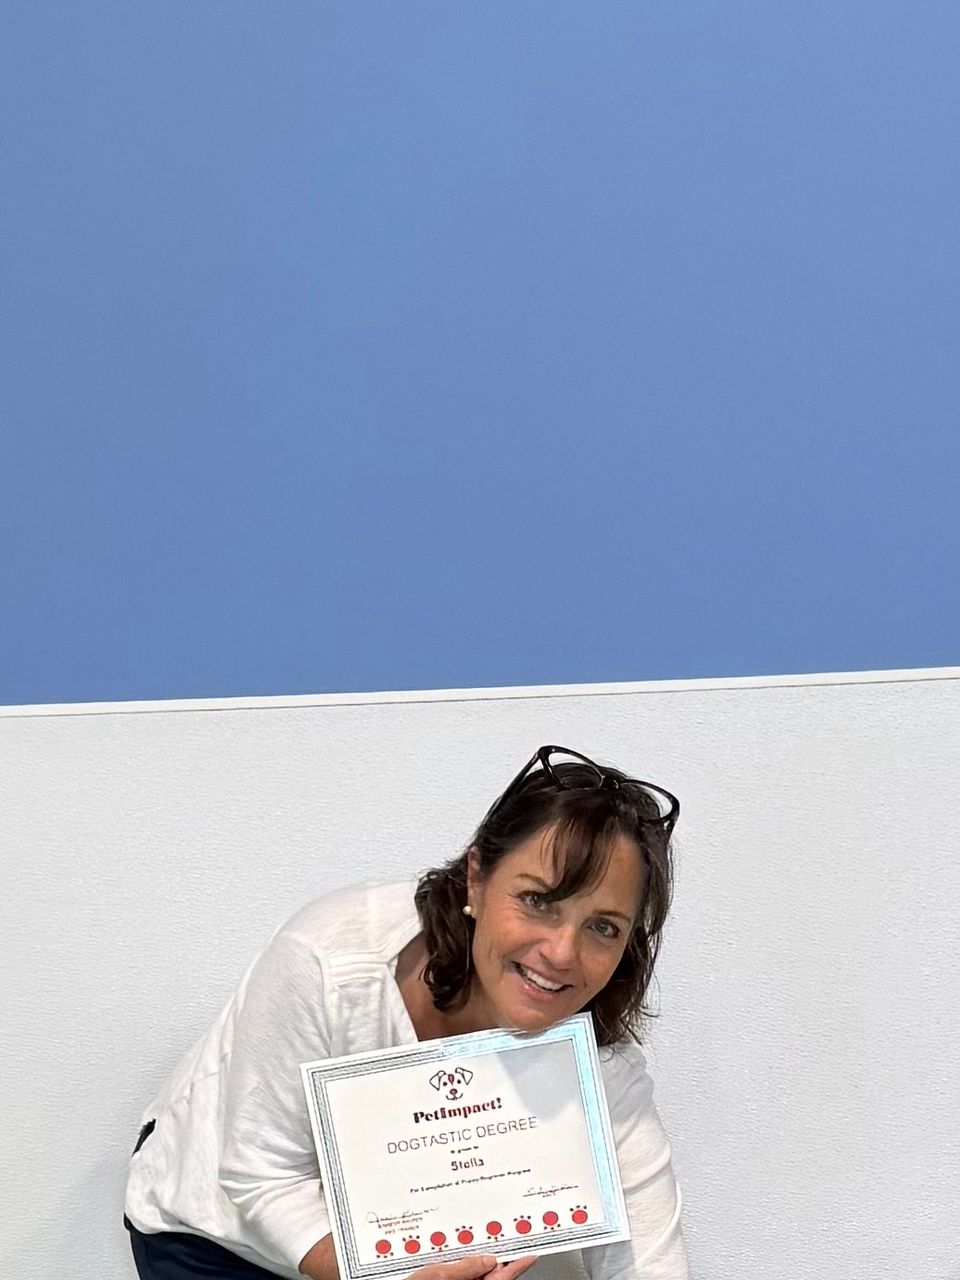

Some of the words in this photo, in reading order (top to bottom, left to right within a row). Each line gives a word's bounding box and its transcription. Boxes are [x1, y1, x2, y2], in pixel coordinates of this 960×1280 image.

[413, 1097, 502, 1123] PetImpact!
[387, 1128, 472, 1154] DOGTASTIC
[476, 1116, 538, 1138] DEGREE
[450, 1157, 484, 1171] Stella
